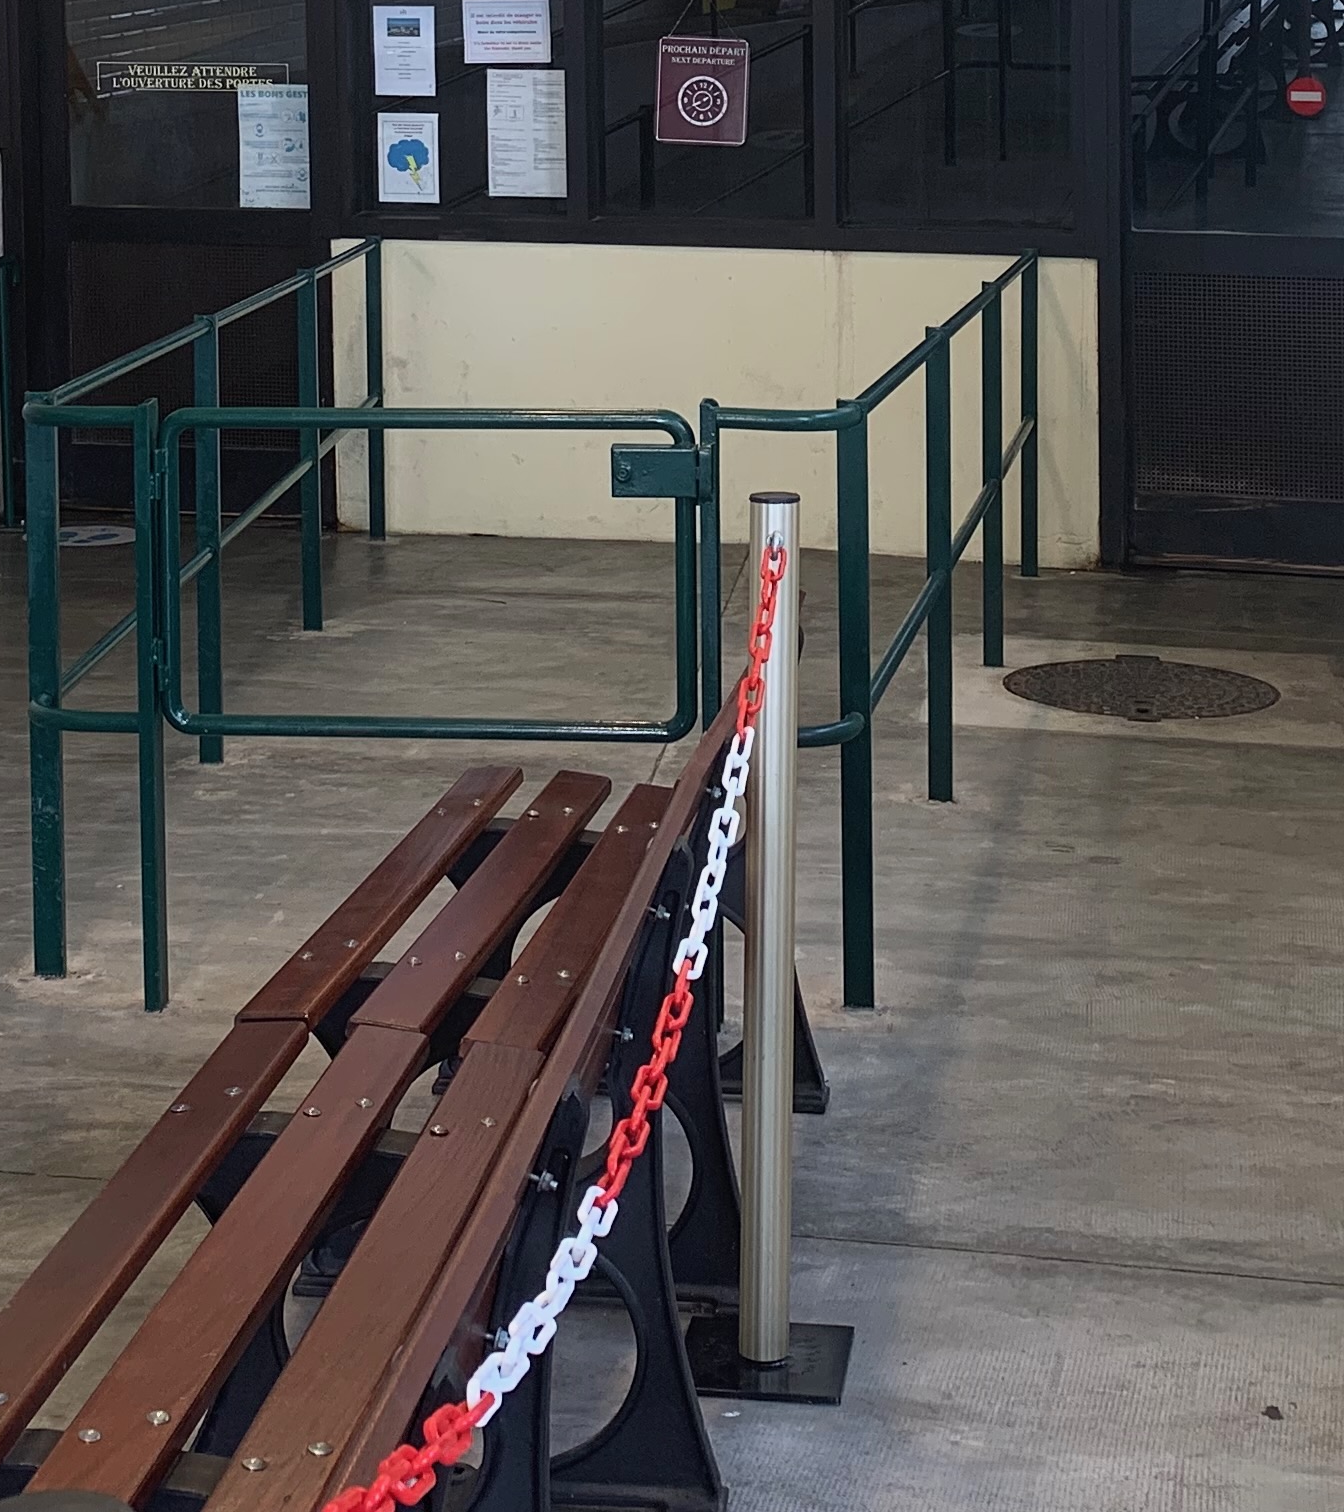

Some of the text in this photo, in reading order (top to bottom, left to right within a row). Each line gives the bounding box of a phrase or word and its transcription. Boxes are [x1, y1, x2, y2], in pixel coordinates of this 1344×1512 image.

[662, 45, 707, 55] PROCHAIN
[671, 56, 736, 66] NEXT DEPARTURE
[128, 65, 257, 77] VEUILLEZ ATTENDRE
[113, 78, 195, 88] L'OUVERTURE
[199, 79, 223, 88] DES
